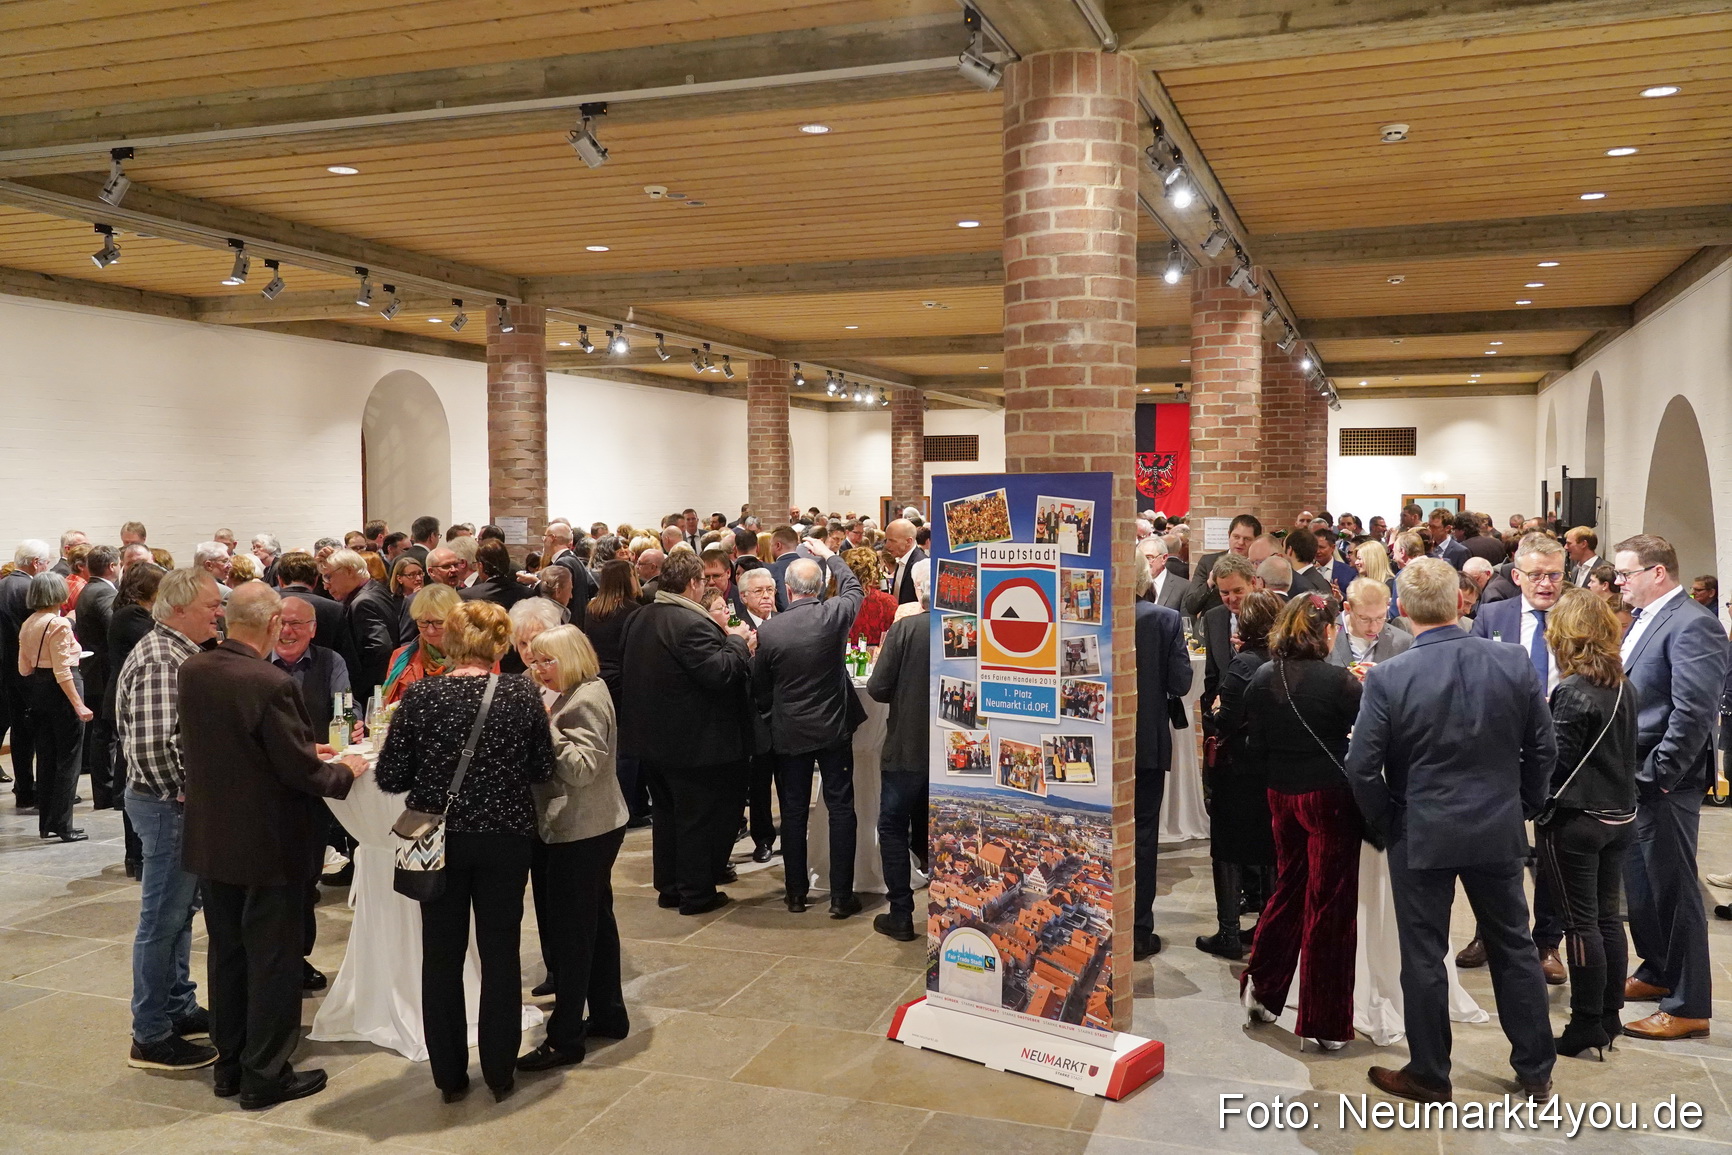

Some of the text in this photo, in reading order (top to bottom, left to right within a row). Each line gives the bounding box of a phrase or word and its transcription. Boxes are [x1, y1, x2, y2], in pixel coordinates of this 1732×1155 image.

[980, 547, 1056, 562] Hauptstadt
[992, 674, 1010, 682] Fairen
[1013, 676, 1038, 684] Handels
[1004, 688, 1032, 698] 1. Platz
[986, 698, 1050, 712] Neumarkt i.d.OPf.
[1020, 1048, 1087, 1074] NEUMARKT
